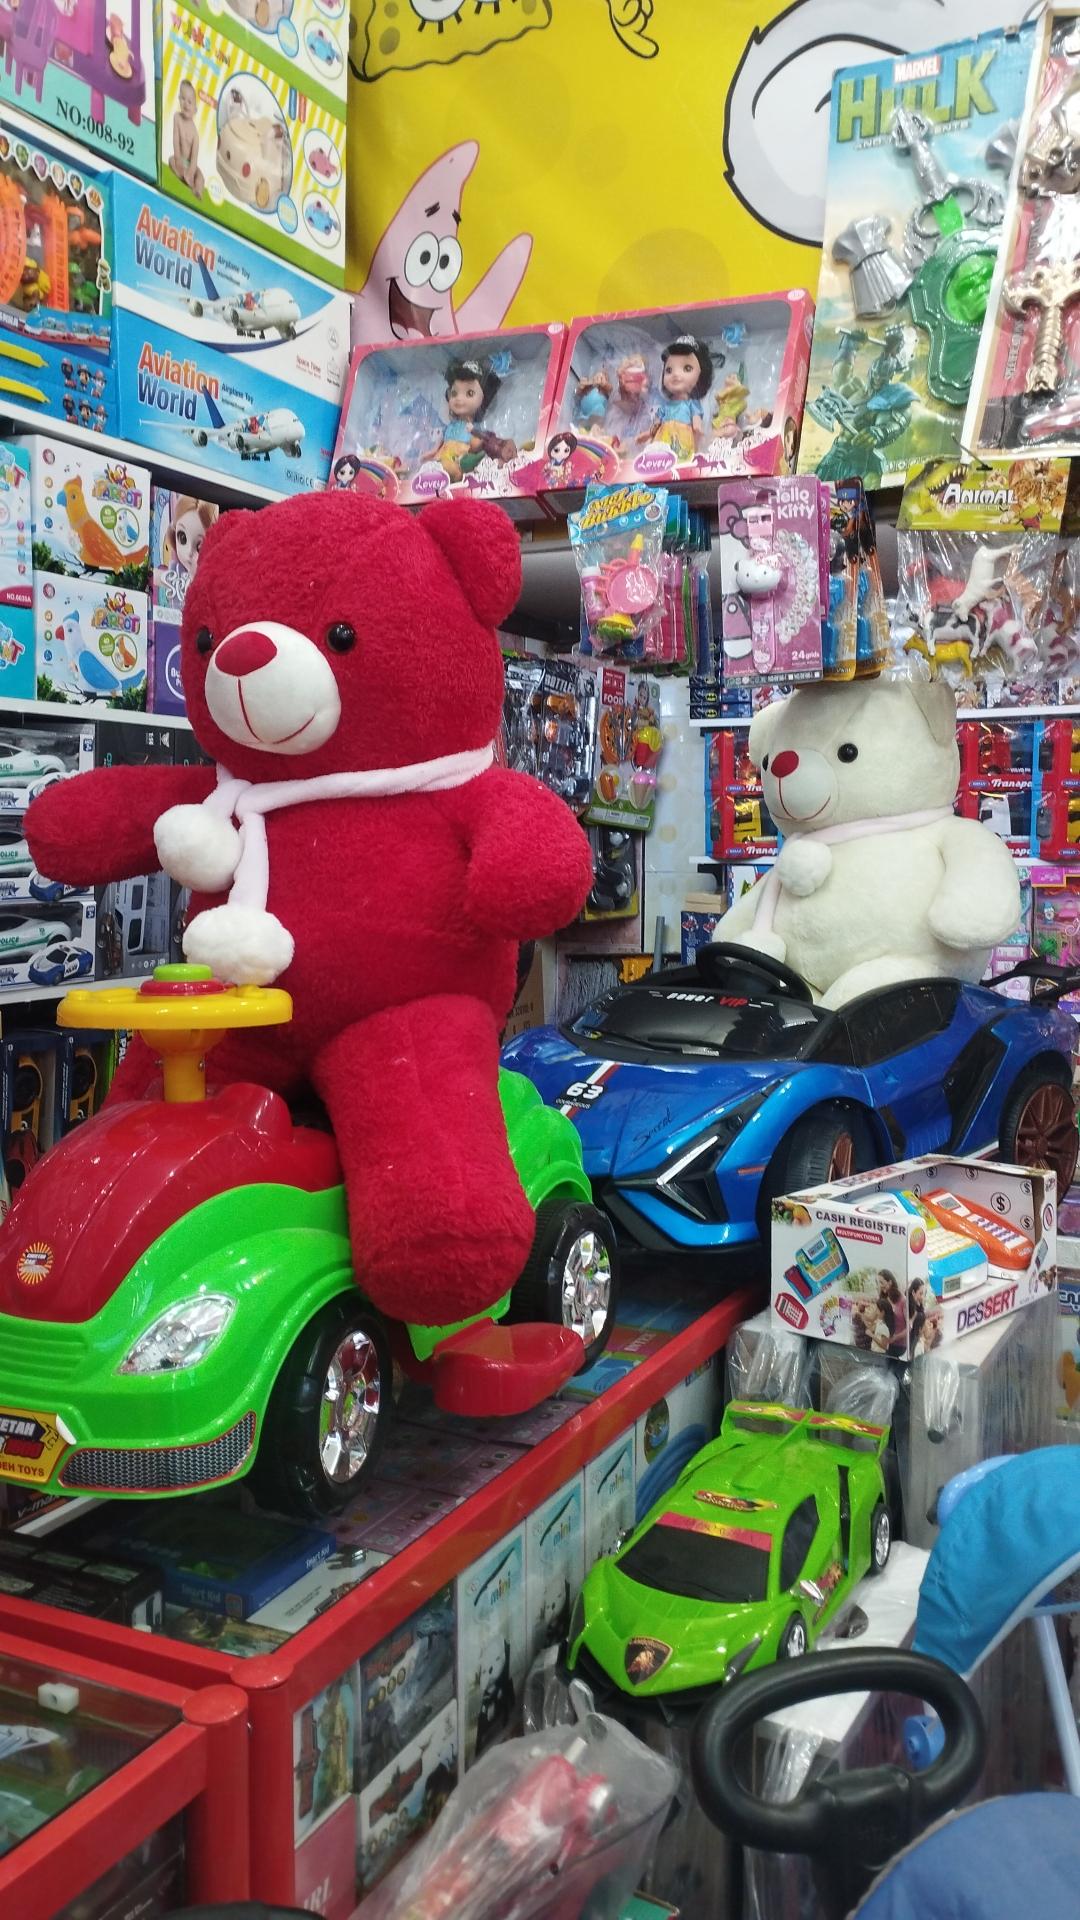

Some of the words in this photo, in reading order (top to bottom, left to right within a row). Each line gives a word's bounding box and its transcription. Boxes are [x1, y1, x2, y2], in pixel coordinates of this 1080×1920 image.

[895, 56, 940, 82] MARVEL
[837, 49, 998, 143] HULK
[56, 96, 134, 156] NO:008-92
[136, 204, 216, 271] Aviation
[136, 234, 192, 290] World
[138, 343, 219, 400] Aviation
[138, 373, 197, 421] World
[768, 487, 809, 504] Hello
[942, 484, 1018, 504] ANIMAL
[778, 504, 815, 519] Kitty
[566, 1082, 604, 1100] 63
[815, 1210, 846, 1223] CASH
[849, 1216, 907, 1236] REGISTER
[836, 1228, 882, 1243] MULTIFUNCTIONAL
[957, 1284, 1018, 1333] DESSERT
[17, 1464, 45, 1477] TOYS
